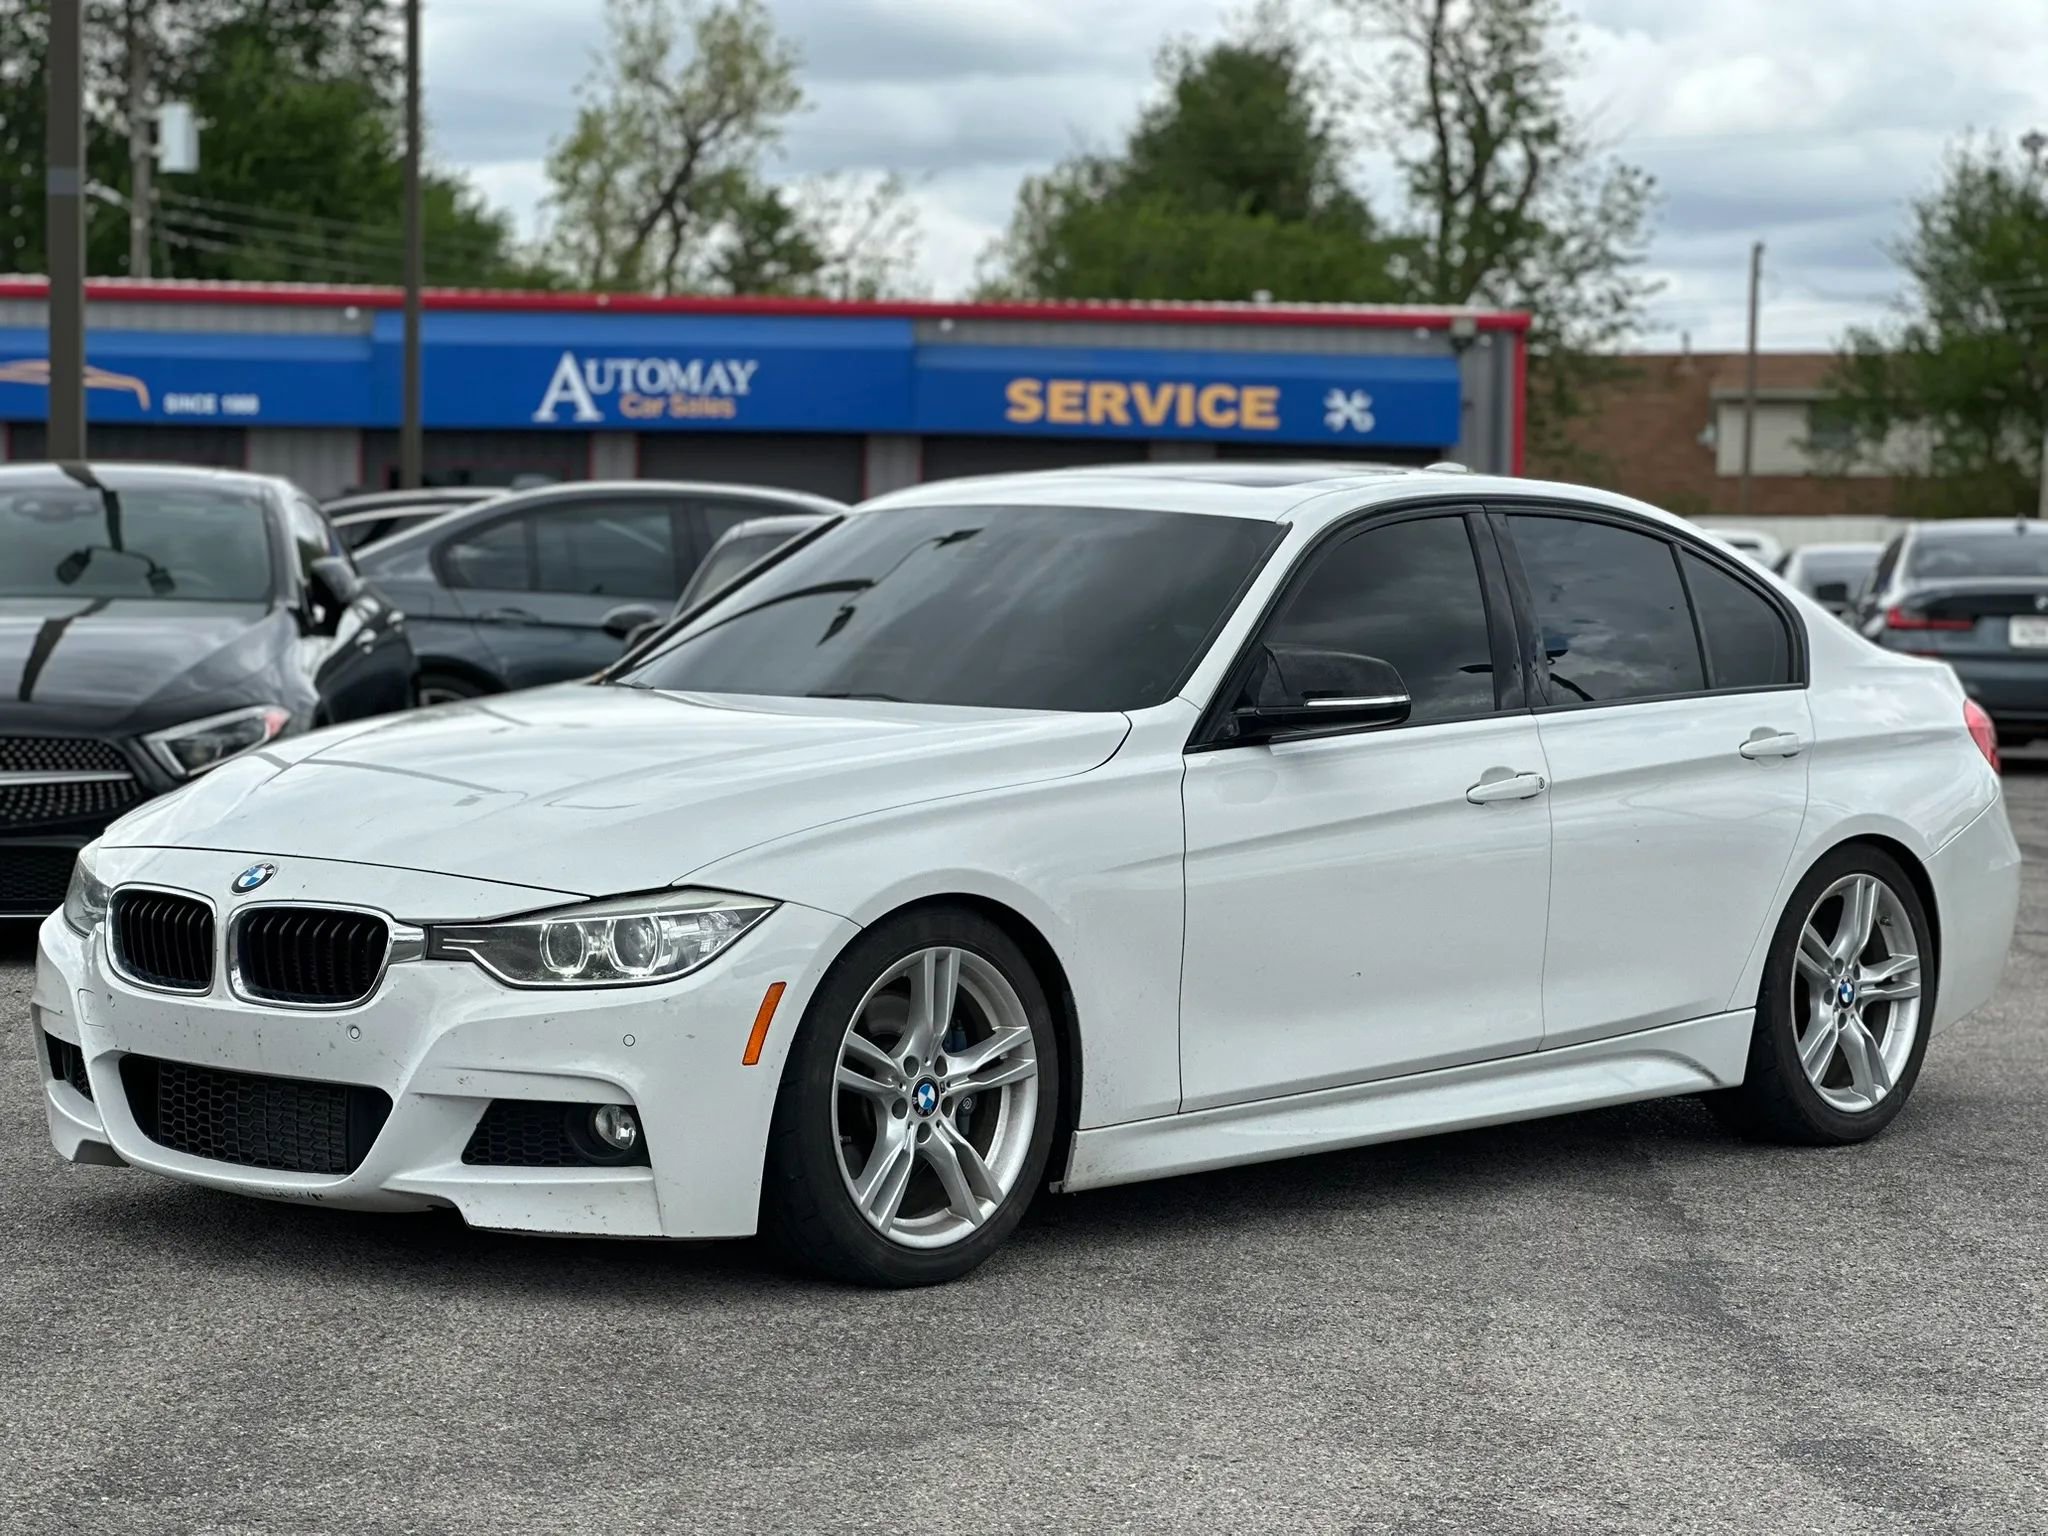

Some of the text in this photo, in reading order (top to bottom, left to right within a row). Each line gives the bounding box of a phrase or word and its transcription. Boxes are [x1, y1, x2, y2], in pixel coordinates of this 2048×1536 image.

[163, 393, 217, 414] SINCE
[532, 351, 758, 422] AUTOMAY
[619, 393, 736, 418] Car Sales
[1006, 378, 1280, 430] SERVICE
